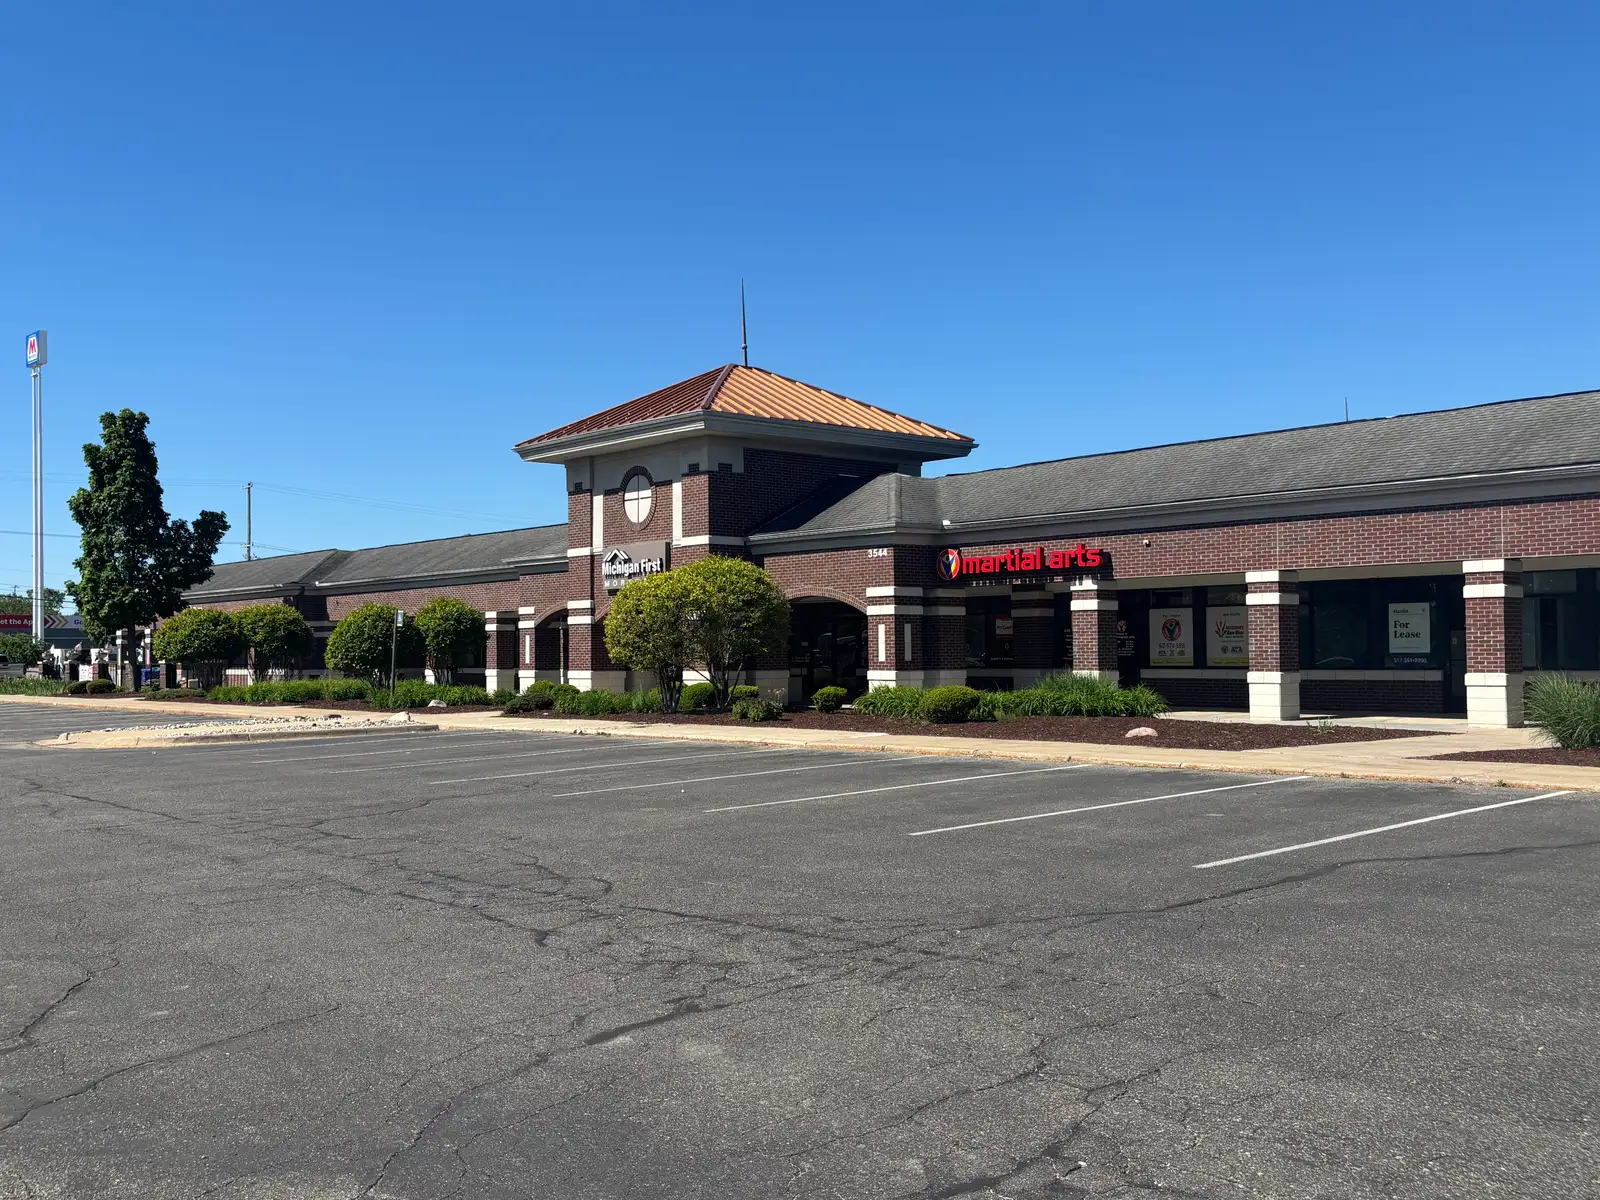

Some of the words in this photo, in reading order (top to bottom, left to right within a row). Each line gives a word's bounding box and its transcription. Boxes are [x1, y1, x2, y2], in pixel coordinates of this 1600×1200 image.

[867, 548, 888, 558] 3544
[962, 545, 1041, 574] martial
[1049, 543, 1102, 569] arts
[602, 561, 640, 576] Michigan
[640, 557, 661, 573] First
[23, 618, 33, 627] Ap
[1394, 620, 1410, 629] For
[1394, 630, 1421, 639] Lease
